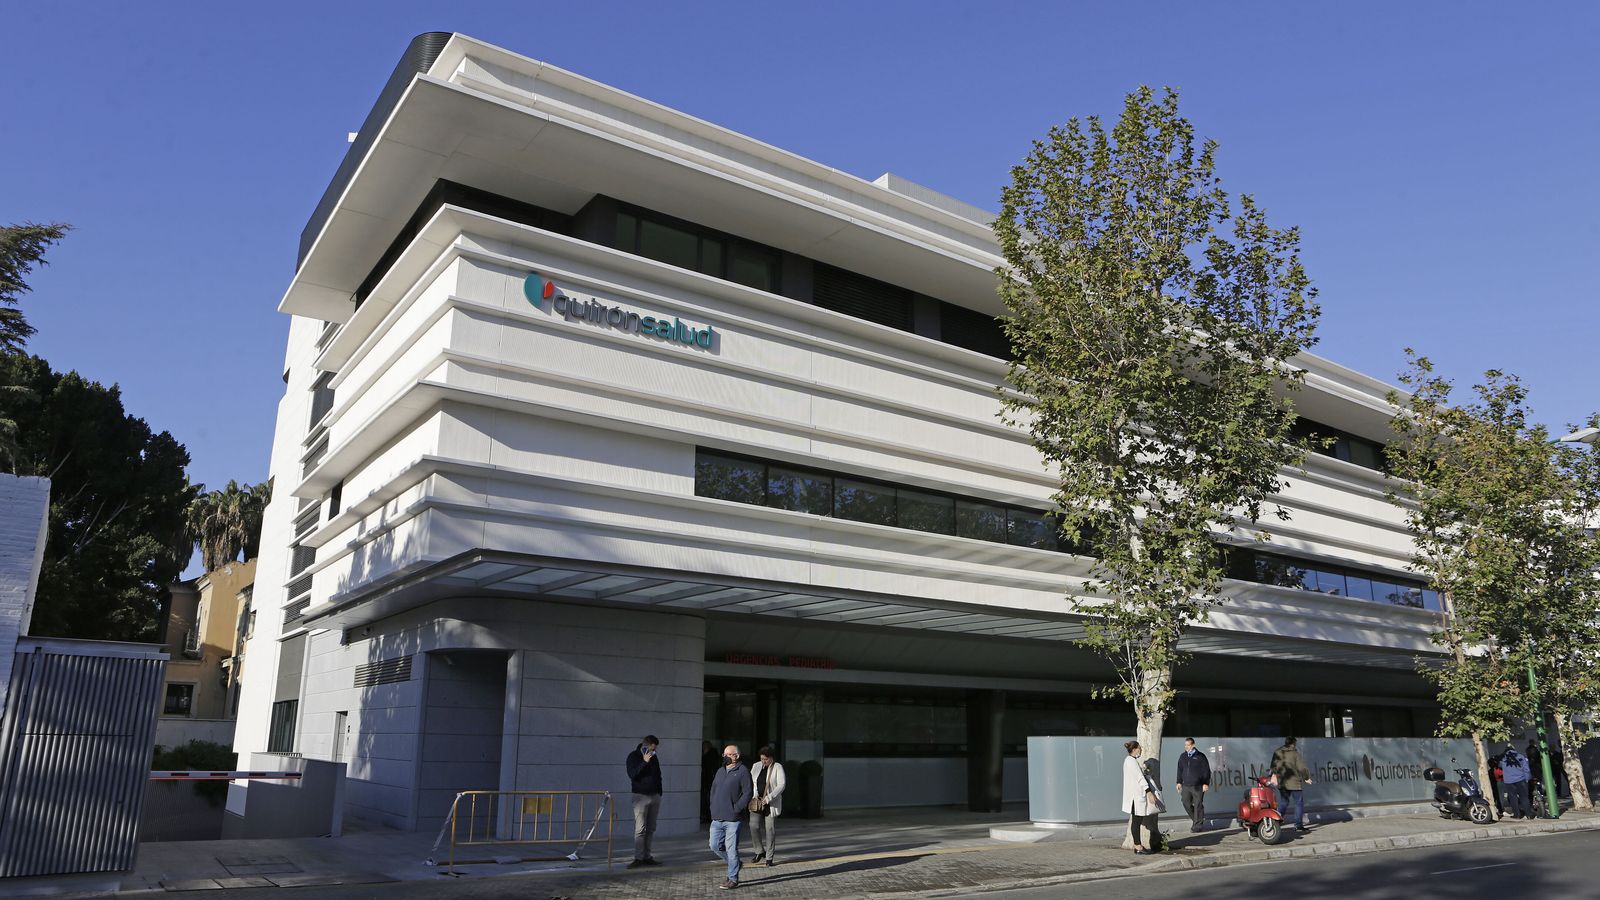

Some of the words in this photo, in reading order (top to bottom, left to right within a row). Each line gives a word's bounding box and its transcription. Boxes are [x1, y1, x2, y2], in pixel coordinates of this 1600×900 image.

[553, 294, 712, 349] quirónsalud
[1209, 764, 1247, 792] pital
[1375, 760, 1437, 787] quirónsa
